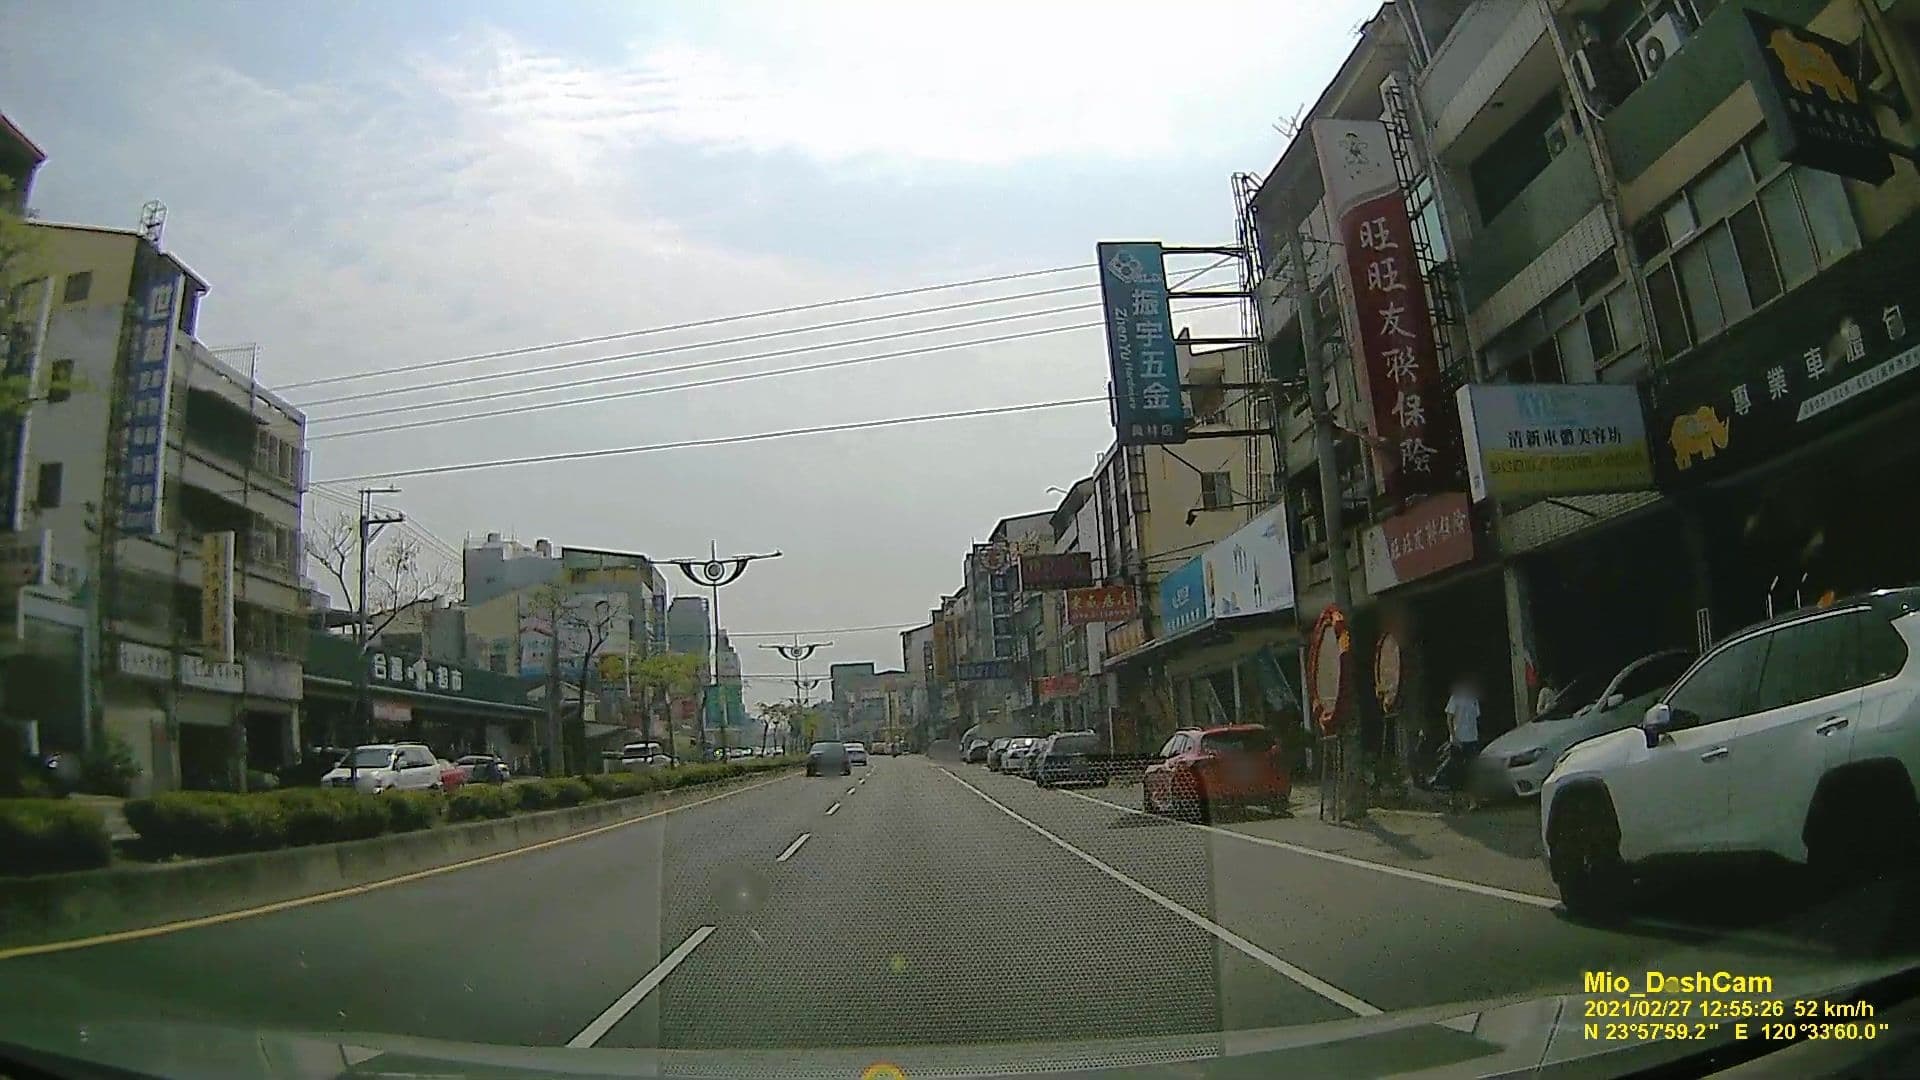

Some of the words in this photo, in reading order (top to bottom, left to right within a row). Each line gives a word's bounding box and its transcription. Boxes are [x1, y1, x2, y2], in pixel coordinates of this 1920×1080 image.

[1131, 288, 1170, 409] 振宇五金
[1359, 215, 1439, 474] 旺旺友聯保險
